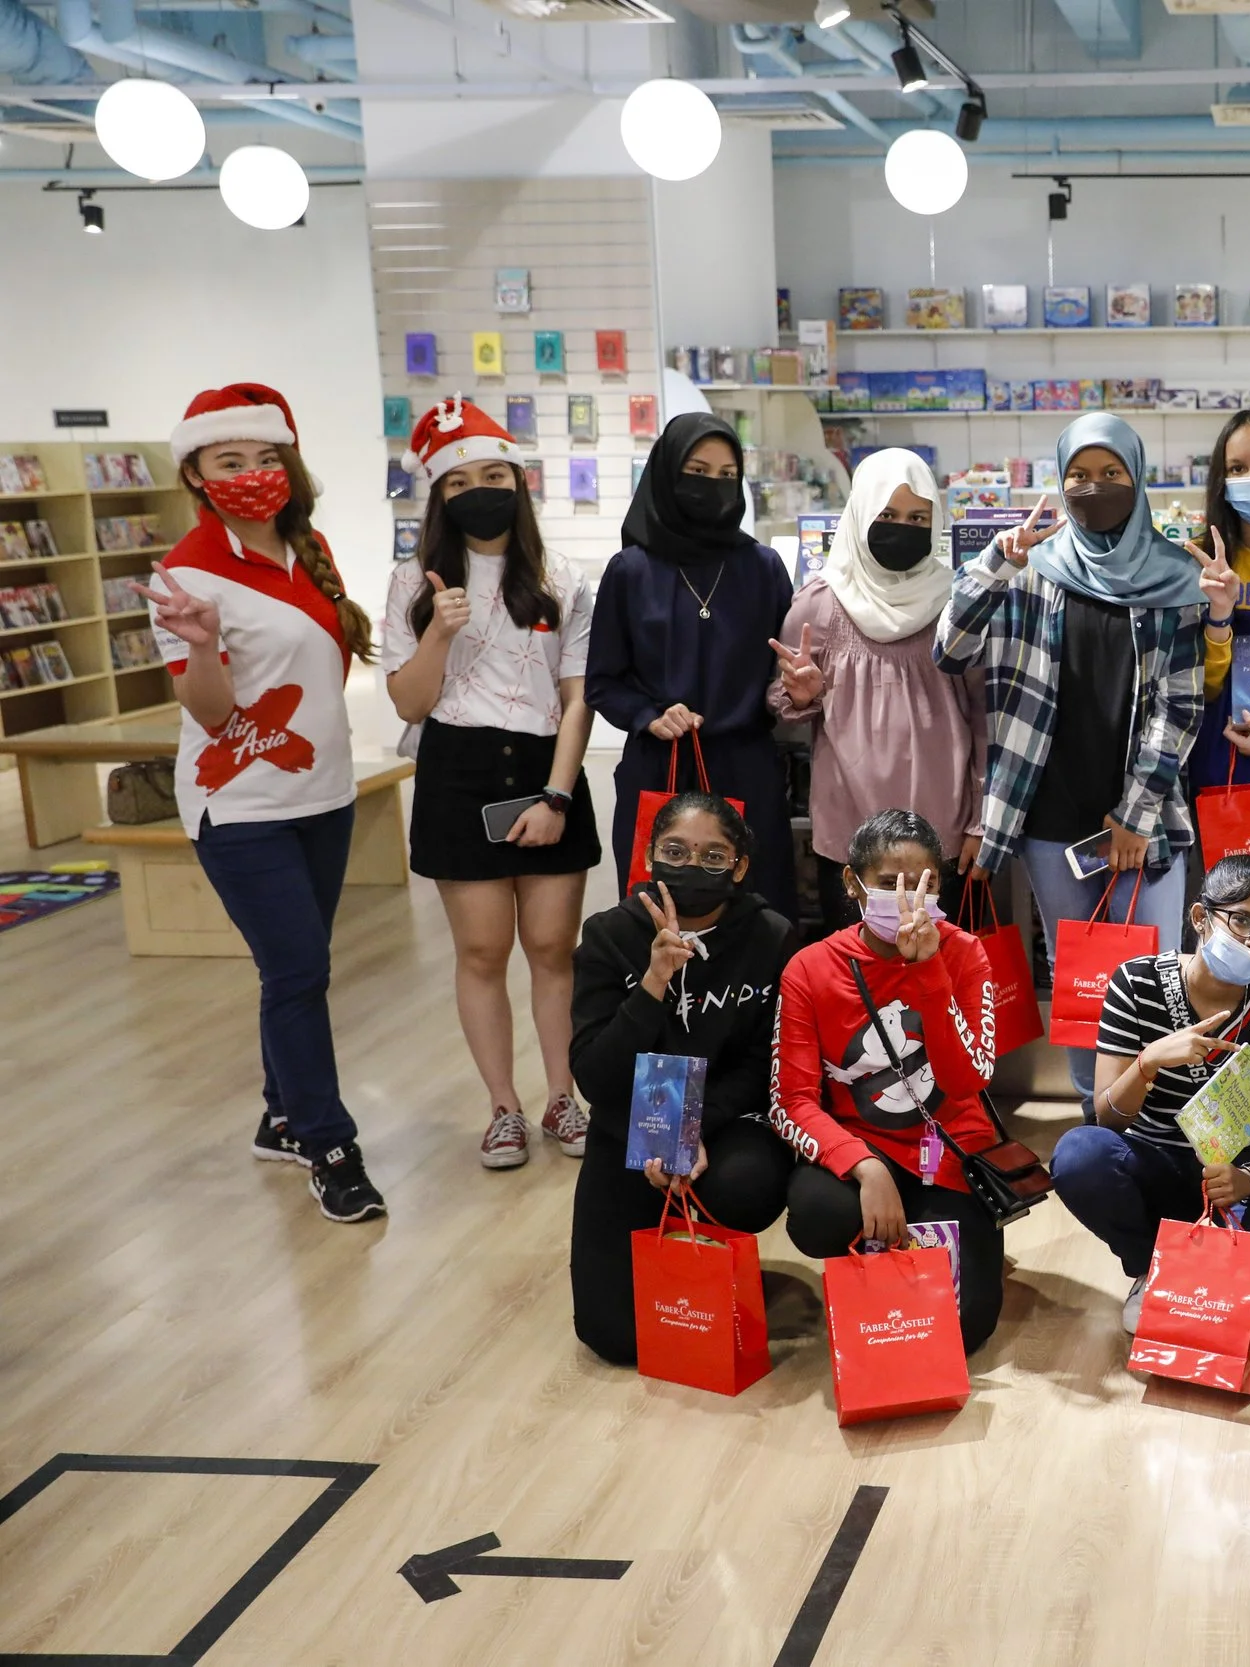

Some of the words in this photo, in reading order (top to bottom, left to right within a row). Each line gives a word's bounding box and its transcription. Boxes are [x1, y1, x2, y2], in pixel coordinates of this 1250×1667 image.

[214, 711, 256, 746] Air
[233, 729, 289, 765] Asia
[1073, 977, 1109, 989] FABER-CA
[1167, 1291, 1232, 1312] FABER-CASTELL
[655, 1301, 713, 1321] FABER-CASTELL
[1169, 1308, 1201, 1320] Companion
[1202, 1314, 1212, 1322] for
[860, 1317, 933, 1334] FABER-CASTELL
[868, 1336, 904, 1345] Companion
[905, 1333, 917, 1342] for
[917, 1331, 928, 1339] life
